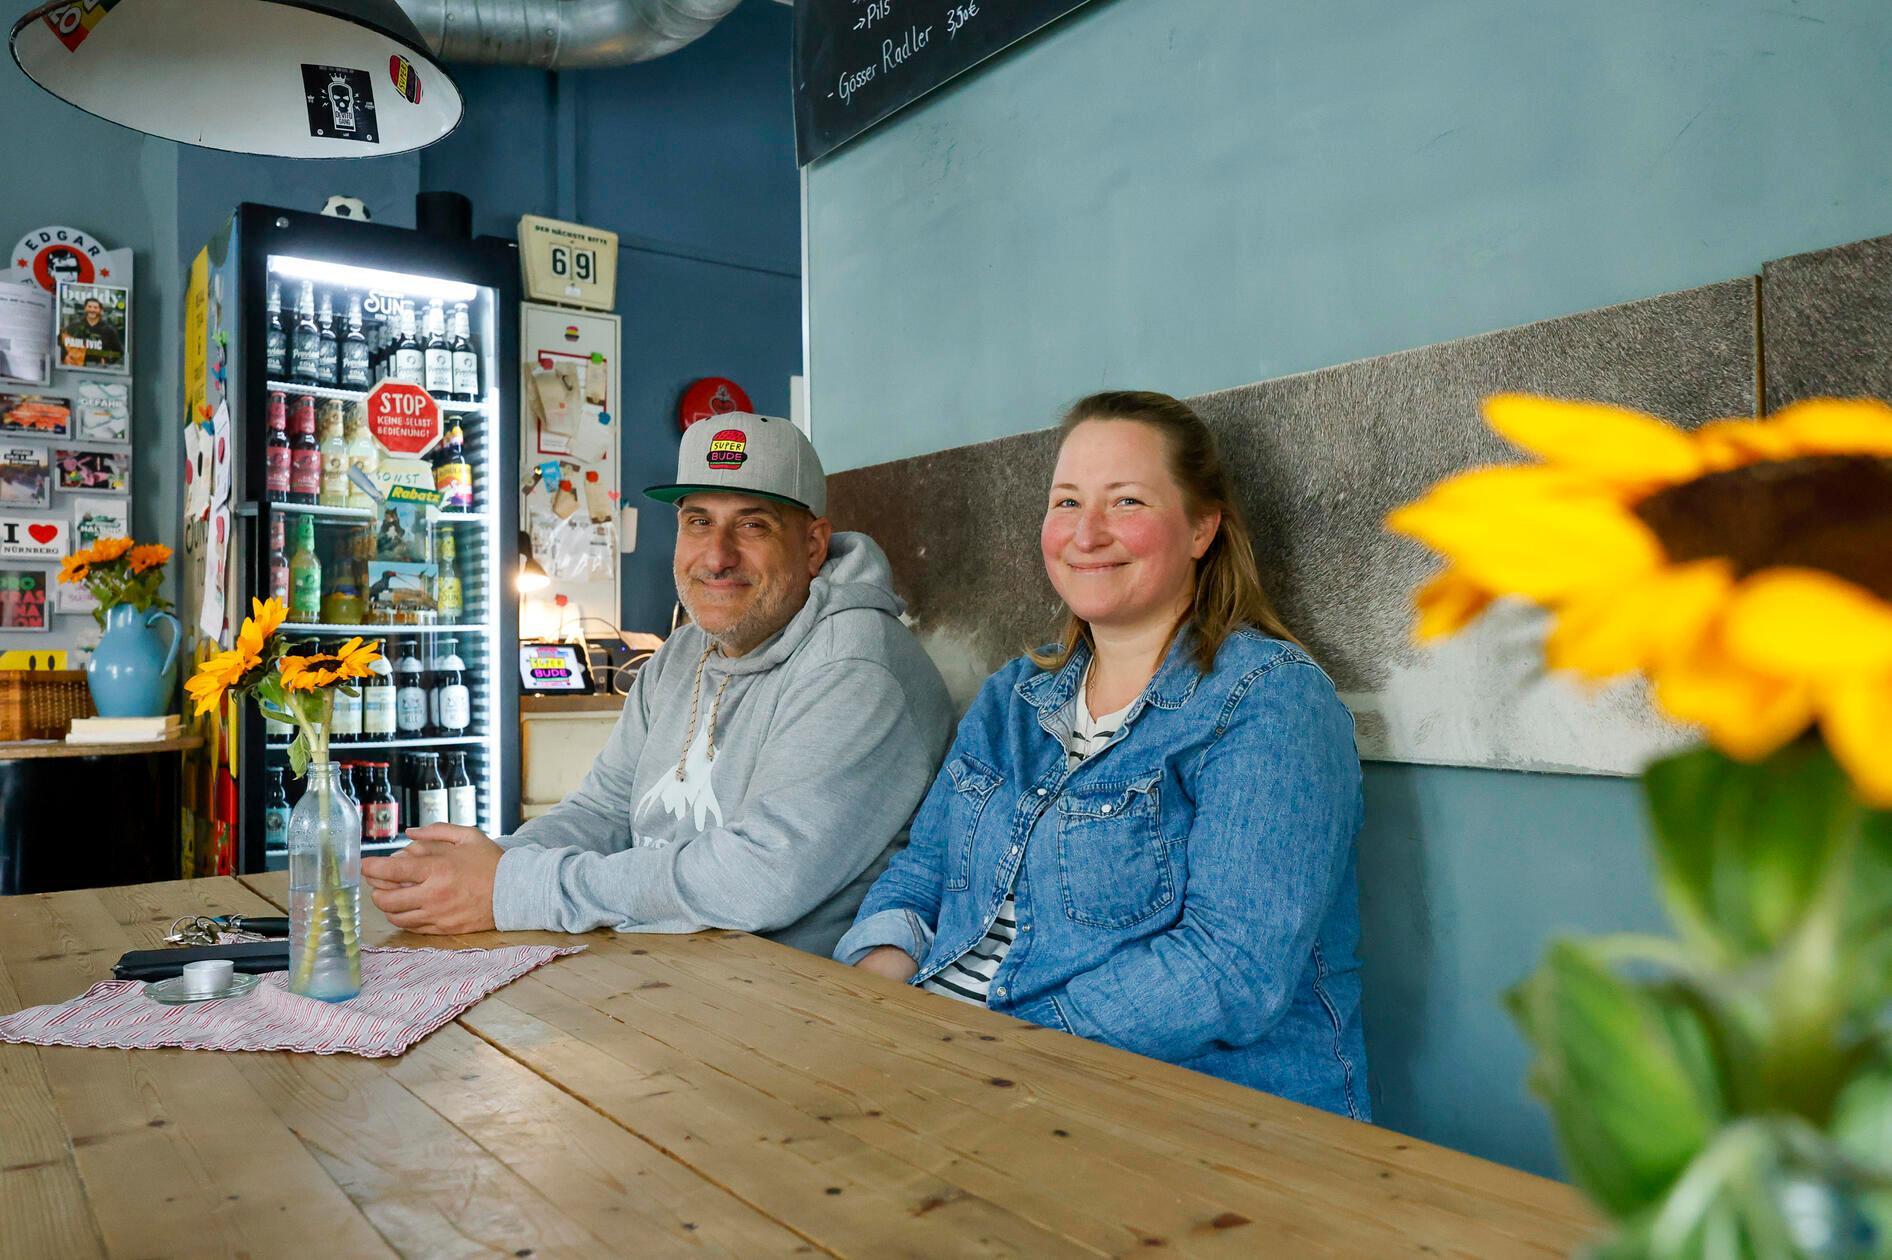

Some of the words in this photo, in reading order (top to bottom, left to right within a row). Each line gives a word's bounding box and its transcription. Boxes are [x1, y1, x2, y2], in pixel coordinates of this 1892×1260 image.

[867, 0, 891, 29] Pils
[838, 64, 877, 106] Gösser
[882, 25, 933, 74] Radler
[25, 230, 100, 257] EDGAR
[380, 392, 426, 416] STOP
[377, 416, 402, 426] KEINE
[377, 426, 430, 437] BEDIENUNG!
[714, 441, 742, 451] SUPER
[711, 452, 742, 461] BUDE
[4, 523, 20, 543] I
[4, 546, 59, 555] NÜRNBERG
[534, 669, 568, 678] BUDE
